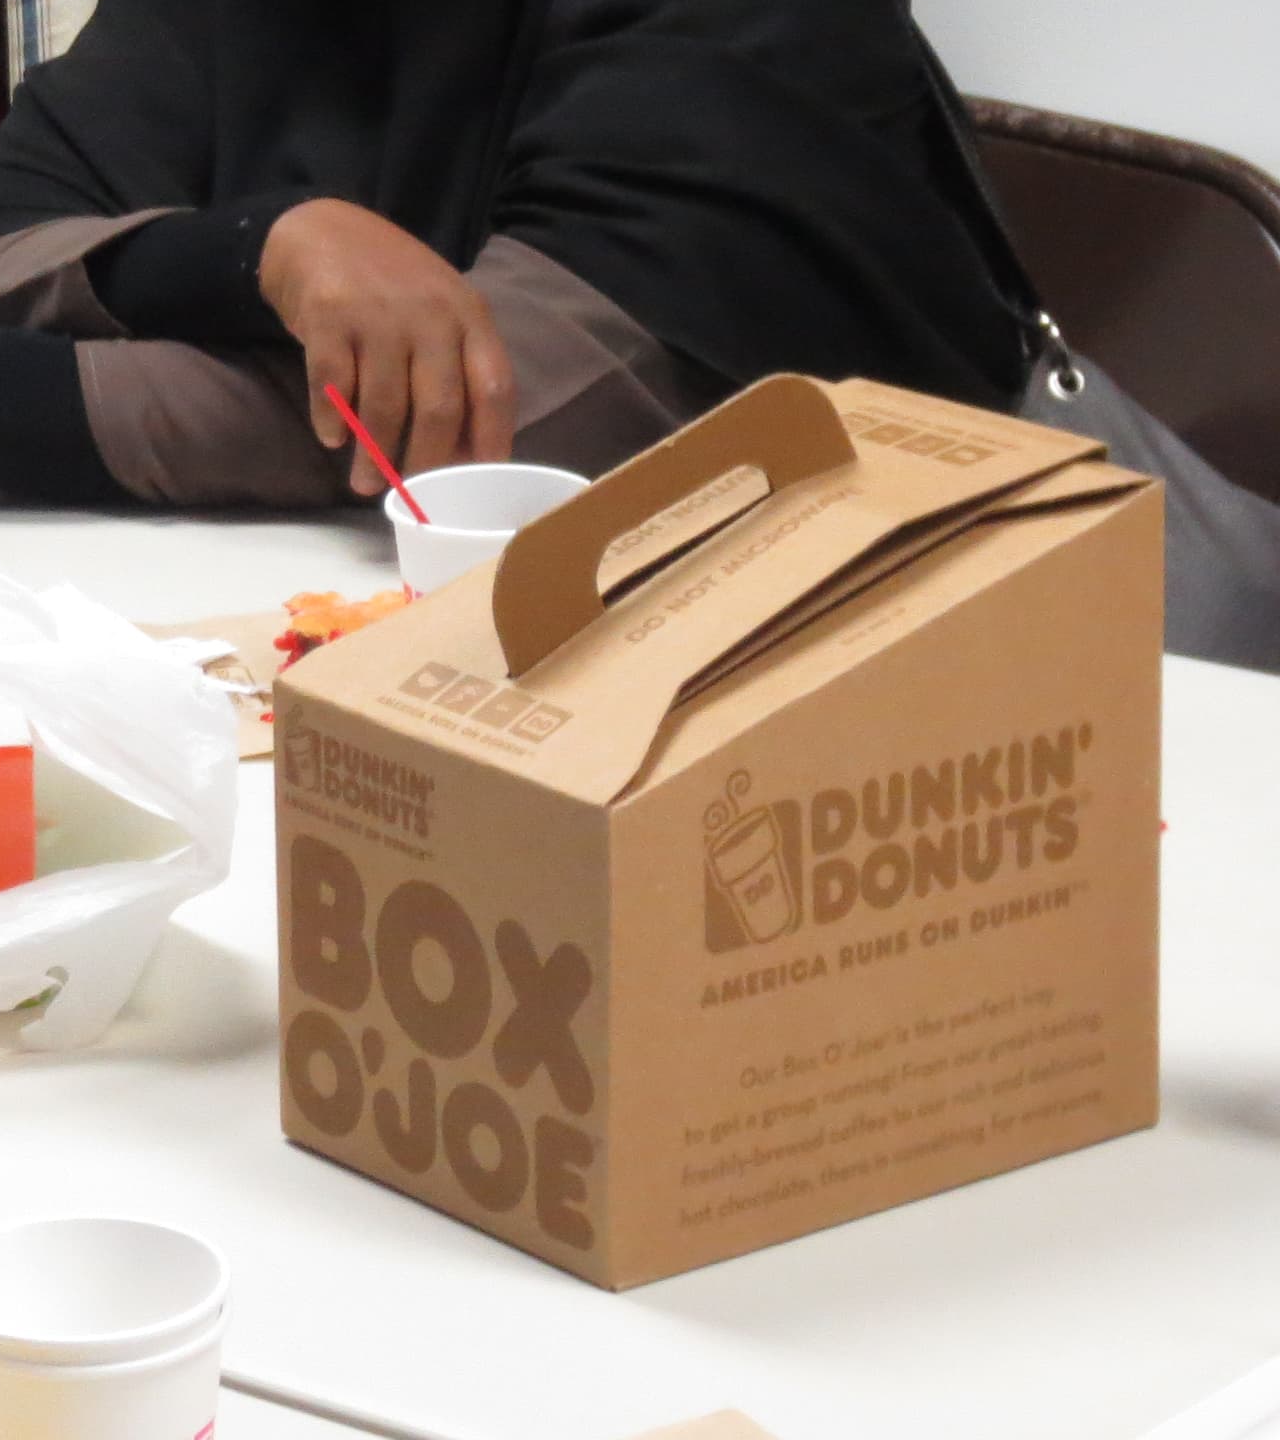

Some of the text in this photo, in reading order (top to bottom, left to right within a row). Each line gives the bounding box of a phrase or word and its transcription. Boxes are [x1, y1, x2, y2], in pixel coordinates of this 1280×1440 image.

[625, 615, 666, 644] DO
[664, 573, 719, 613] NOT
[322, 735, 435, 803] DUNKIN'
[323, 767, 429, 838] DONUTS
[810, 721, 1093, 857] DUNKIN'
[812, 793, 1081, 927] DONUTS
[290, 832, 596, 1116] BOX
[700, 954, 828, 1009] AMERICA
[839, 930, 910, 971] RUNS
[920, 914, 960, 948] ON
[738, 1065, 777, 1090] Our
[782, 1054, 819, 1078] Box
[913, 1013, 946, 1039] the
[948, 993, 1017, 1035] perfect
[284, 1009, 596, 1252] O'JOE
[680, 1127, 825, 1190] freshly-brewed
[828, 1113, 889, 1146] coffee
[915, 1098, 947, 1119] our
[950, 1082, 988, 1106] rich
[990, 1067, 1024, 1096] and
[1026, 1049, 1106, 1085] delicious
[684, 1126, 705, 1146] to
[710, 1112, 740, 1145] get
[745, 1113, 758, 1129] a
[760, 1097, 817, 1130] group
[821, 1066, 898, 1105] running!
[900, 1058, 948, 1082] From
[951, 1047, 984, 1068] our
[679, 1202, 713, 1227] hot
[716, 1178, 815, 1219] chocolate,
[819, 1161, 870, 1188] there
[873, 1152, 889, 1170] is
[893, 1127, 986, 1165] something
[990, 1112, 1018, 1135] for
